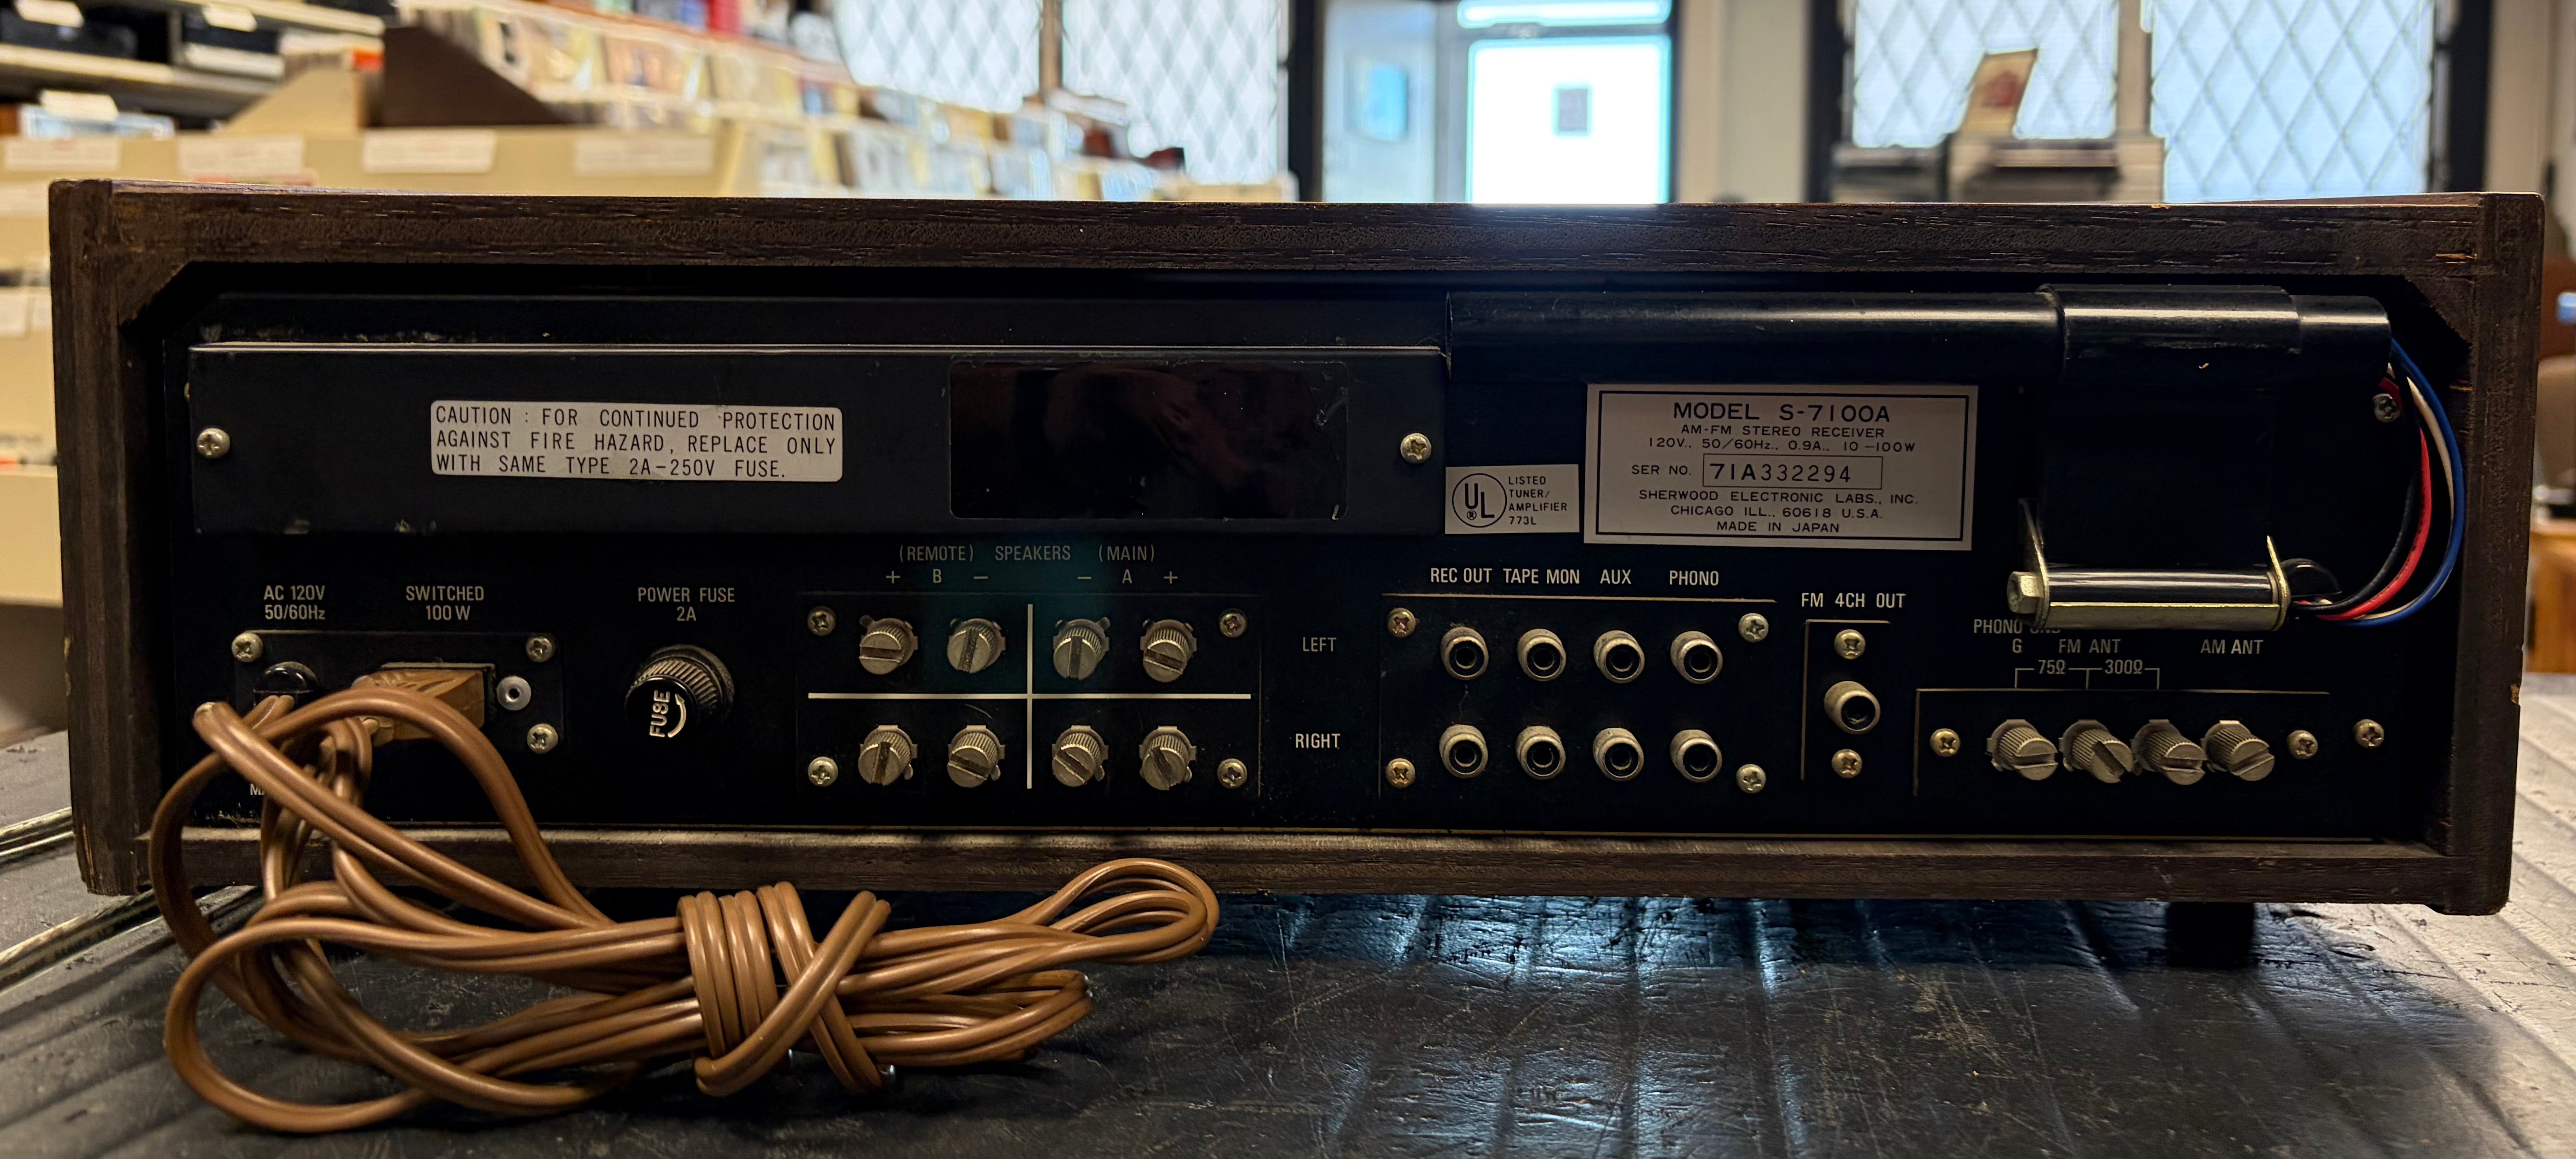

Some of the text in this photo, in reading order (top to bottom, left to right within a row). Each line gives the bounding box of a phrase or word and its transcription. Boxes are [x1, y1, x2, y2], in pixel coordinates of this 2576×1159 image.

[436, 405, 511, 424] CAUTION
[542, 408, 578, 426] FOR
[600, 409, 699, 428] CONTINUED
[723, 412, 834, 431] PROTECTION
[1674, 402, 1890, 423] MODEL S-7100A
[1681, 424, 1884, 438] AM-FM STEREO RECEIVER
[436, 432, 835, 455] AGAINST FIRE HAZARD, REPLACE ONLY
[437, 454, 785, 478] WITH SAME TYPE 2A-250V FUSE.
[1631, 464, 1660, 475] SER
[1669, 465, 1691, 475] NO.
[1508, 476, 1546, 485] LISTED
[1465, 483, 1495, 518] UL
[1509, 489, 1550, 498] TUNER/
[1639, 489, 1719, 501] SHERWOOD
[1731, 491, 1823, 503] ELECTRONIC
[1891, 494, 1918, 504] INC.
[1509, 502, 1567, 512] AMPLIFIER
[1671, 505, 1733, 516] CHICAGO
[1783, 507, 1831, 518] 60618
[1842, 508, 1882, 518] U.S.A.
[1509, 516, 1537, 525] 773L
[1717, 521, 1839, 533] MADE IN JAPAN
[899, 544, 1155, 563] (REMOTE) SPEAKERS (MAIN)
[933, 568, 942, 583] B
[1122, 569, 1132, 584] A
[1430, 567, 1492, 583] REC OUT
[1503, 568, 1579, 584] TAPE MON
[1600, 569, 1631, 585] AUX
[1669, 570, 1719, 586] PHONO
[263, 585, 325, 600] AC 120V
[406, 585, 484, 601] SWITCHED
[638, 587, 735, 603] POWER FUSE
[1802, 592, 1906, 608] FM 4CH OUT
[265, 604, 326, 620] 50/60Hz
[676, 606, 696, 621] 2A
[1974, 619, 2022, 634] PHONO
[1303, 637, 1337, 652] LEFT
[2012, 638, 2022, 653] G
[2059, 638, 2121, 653] FM ANT
[2200, 639, 2264, 654] AM ANT
[2038, 659, 2065, 675] 75Ω
[2105, 659, 2143, 675] 300Ω
[649, 689, 671, 738] FUSE
[1295, 733, 1341, 749] RIGHT
